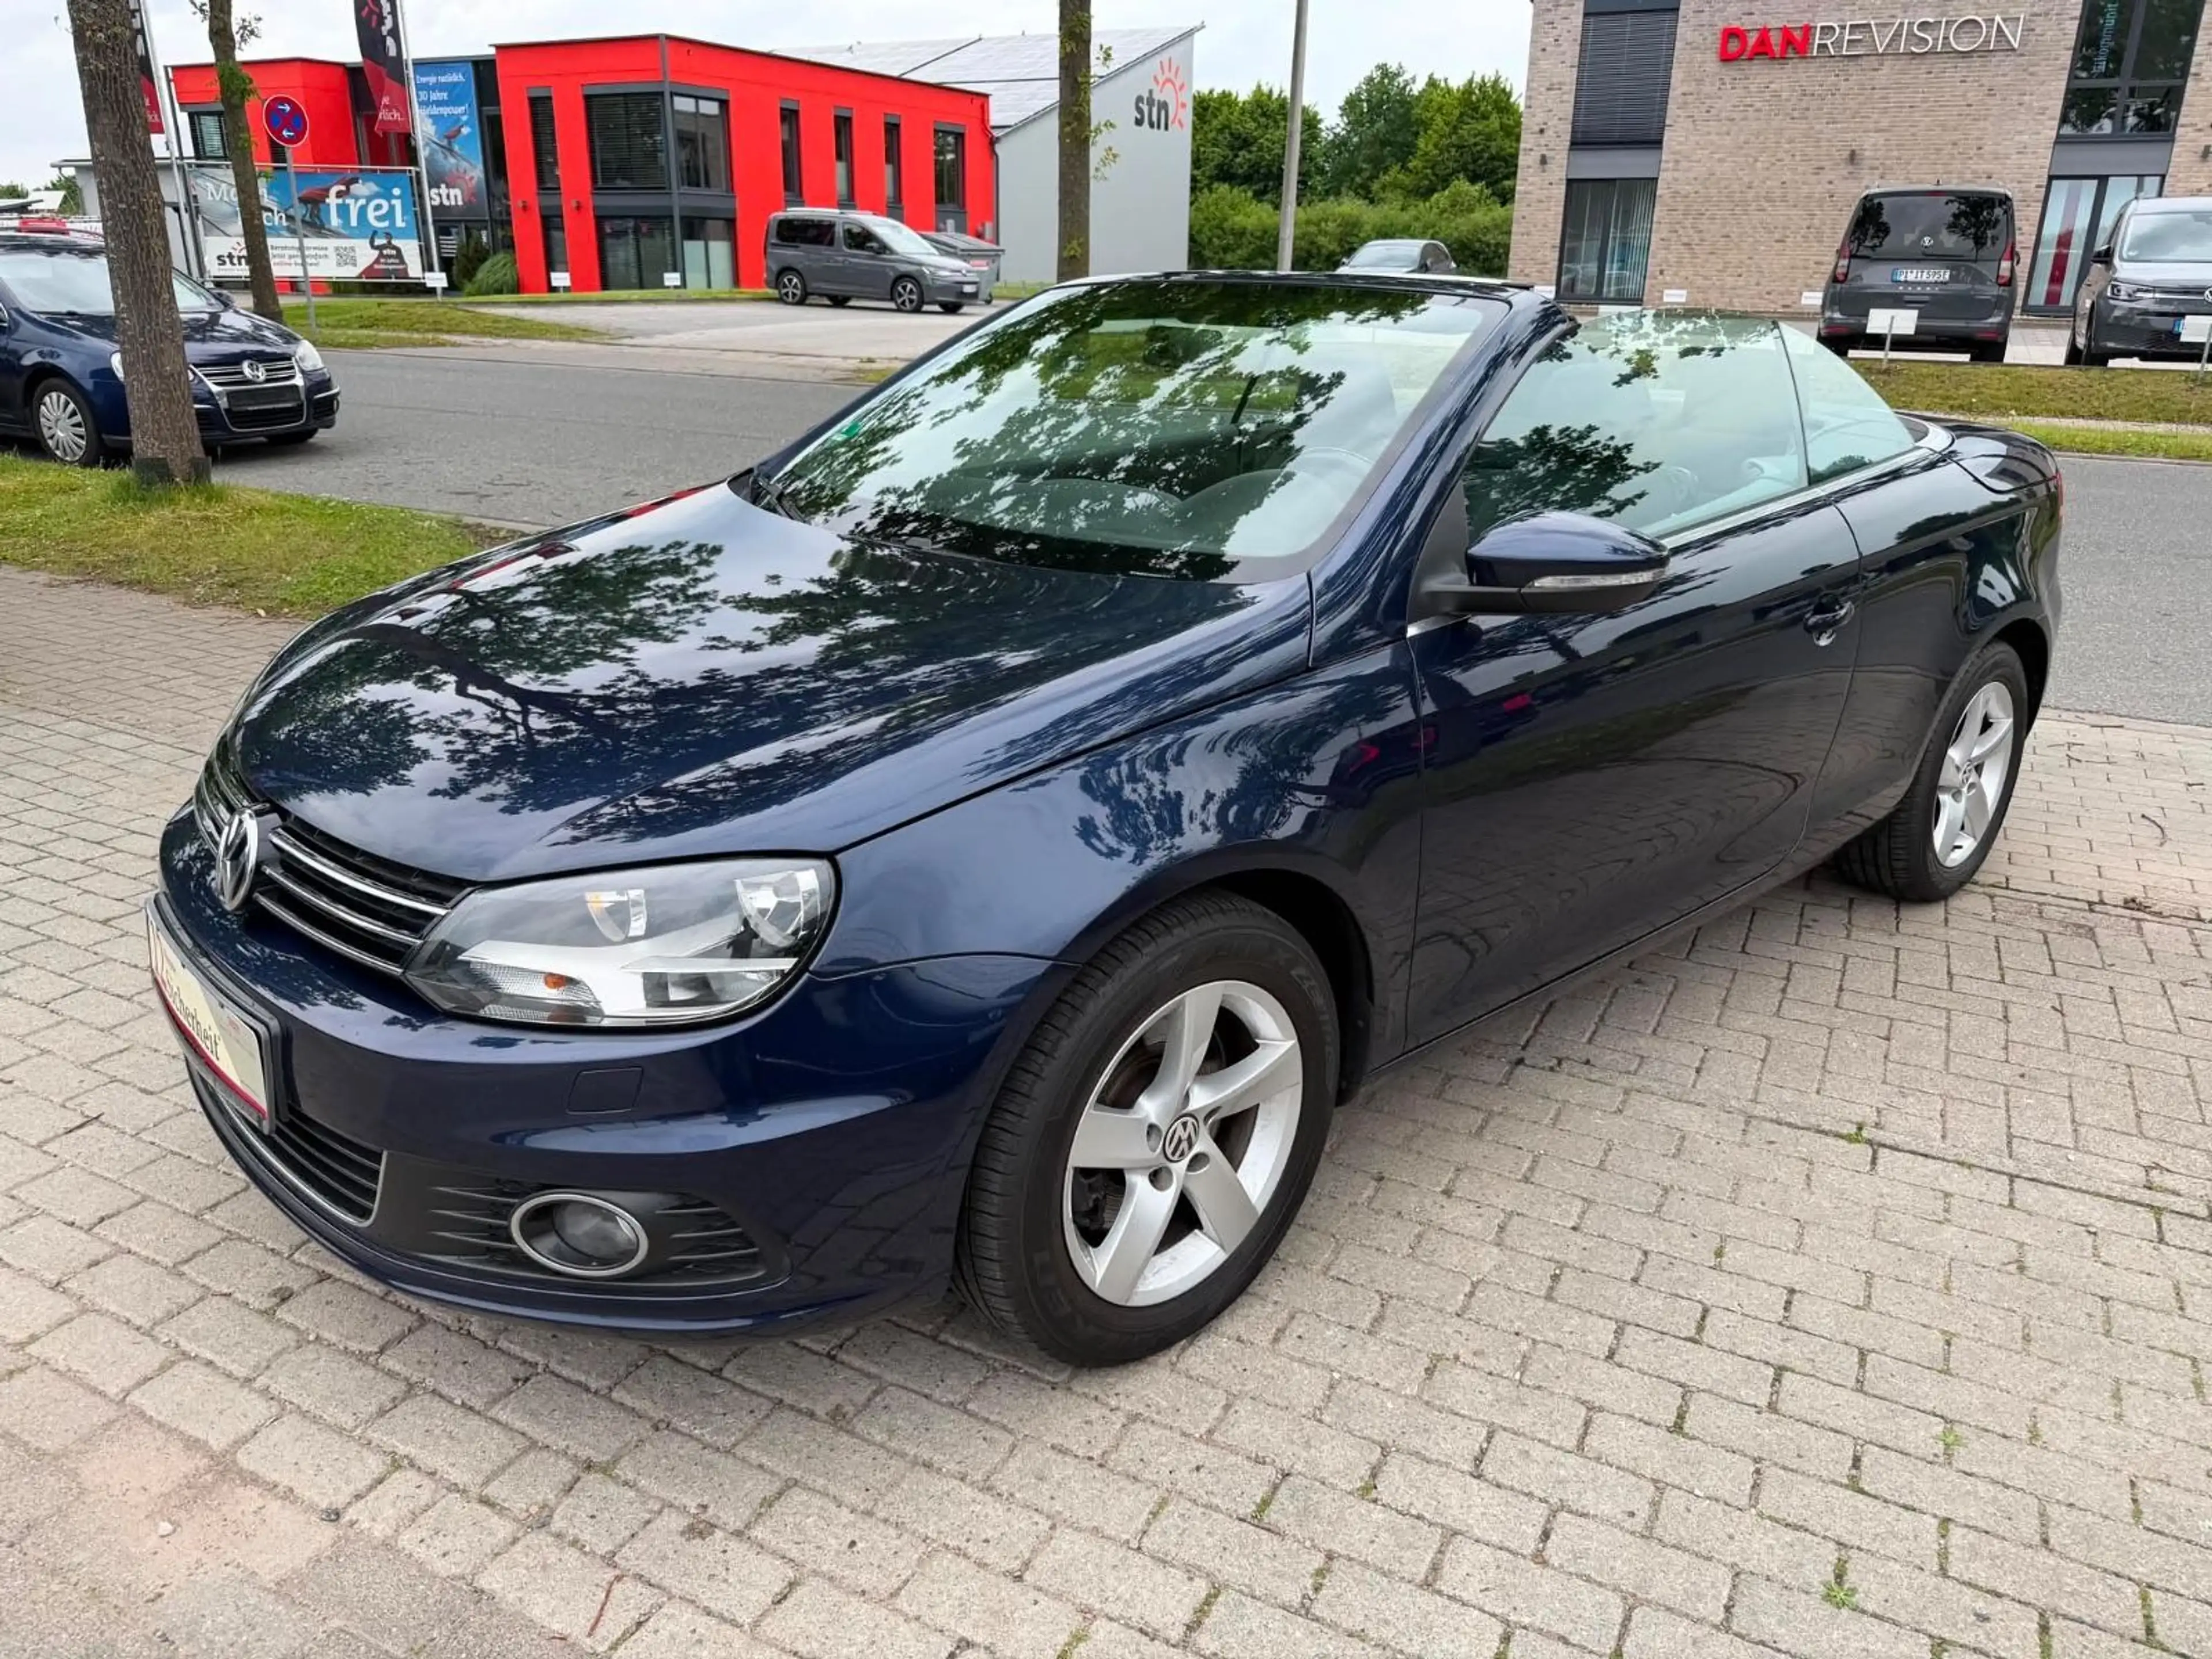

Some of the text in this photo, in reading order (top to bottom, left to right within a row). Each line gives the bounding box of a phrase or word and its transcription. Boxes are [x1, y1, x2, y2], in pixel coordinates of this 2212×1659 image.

[1719, 14, 2024, 62] DANREVISION
[1134, 88, 1169, 131] stn
[325, 184, 406, 228] frei
[430, 183, 464, 206] stn
